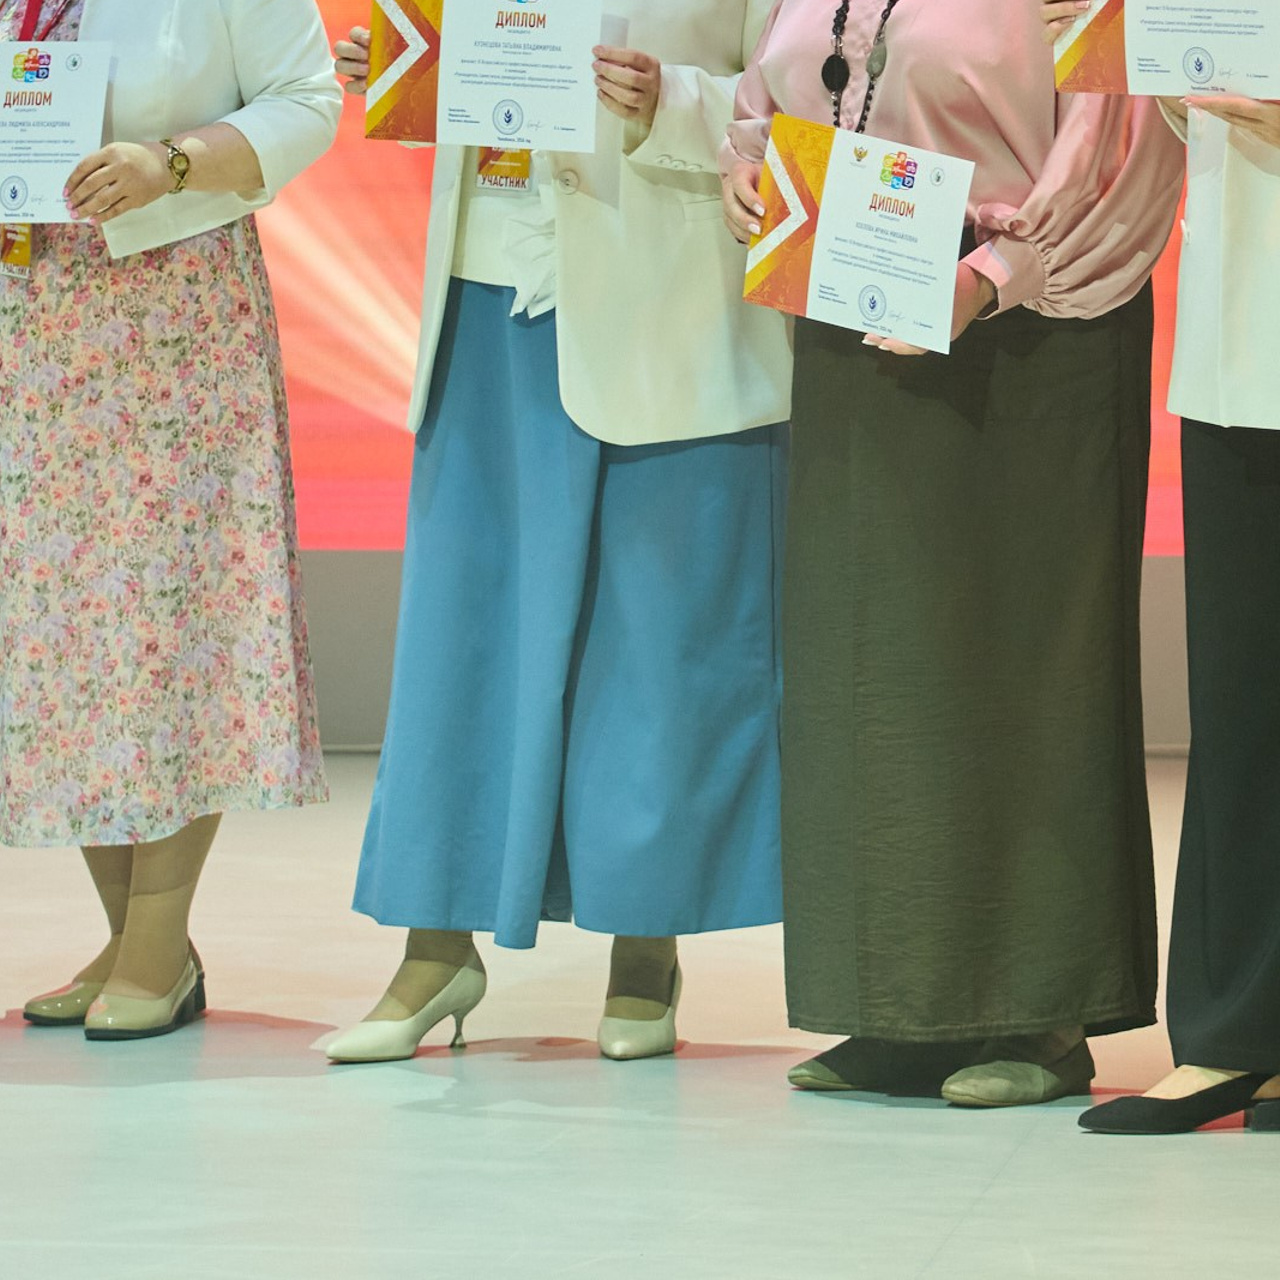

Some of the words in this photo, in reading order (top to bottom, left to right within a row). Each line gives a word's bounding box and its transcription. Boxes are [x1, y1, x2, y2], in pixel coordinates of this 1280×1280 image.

[495, 10, 546, 29] ДИПЛОМ
[3, 91, 52, 108] ДИПЛОМ
[481, 175, 527, 189] УЧАСТНИК
[868, 192, 916, 219] ДИПЛОМ
